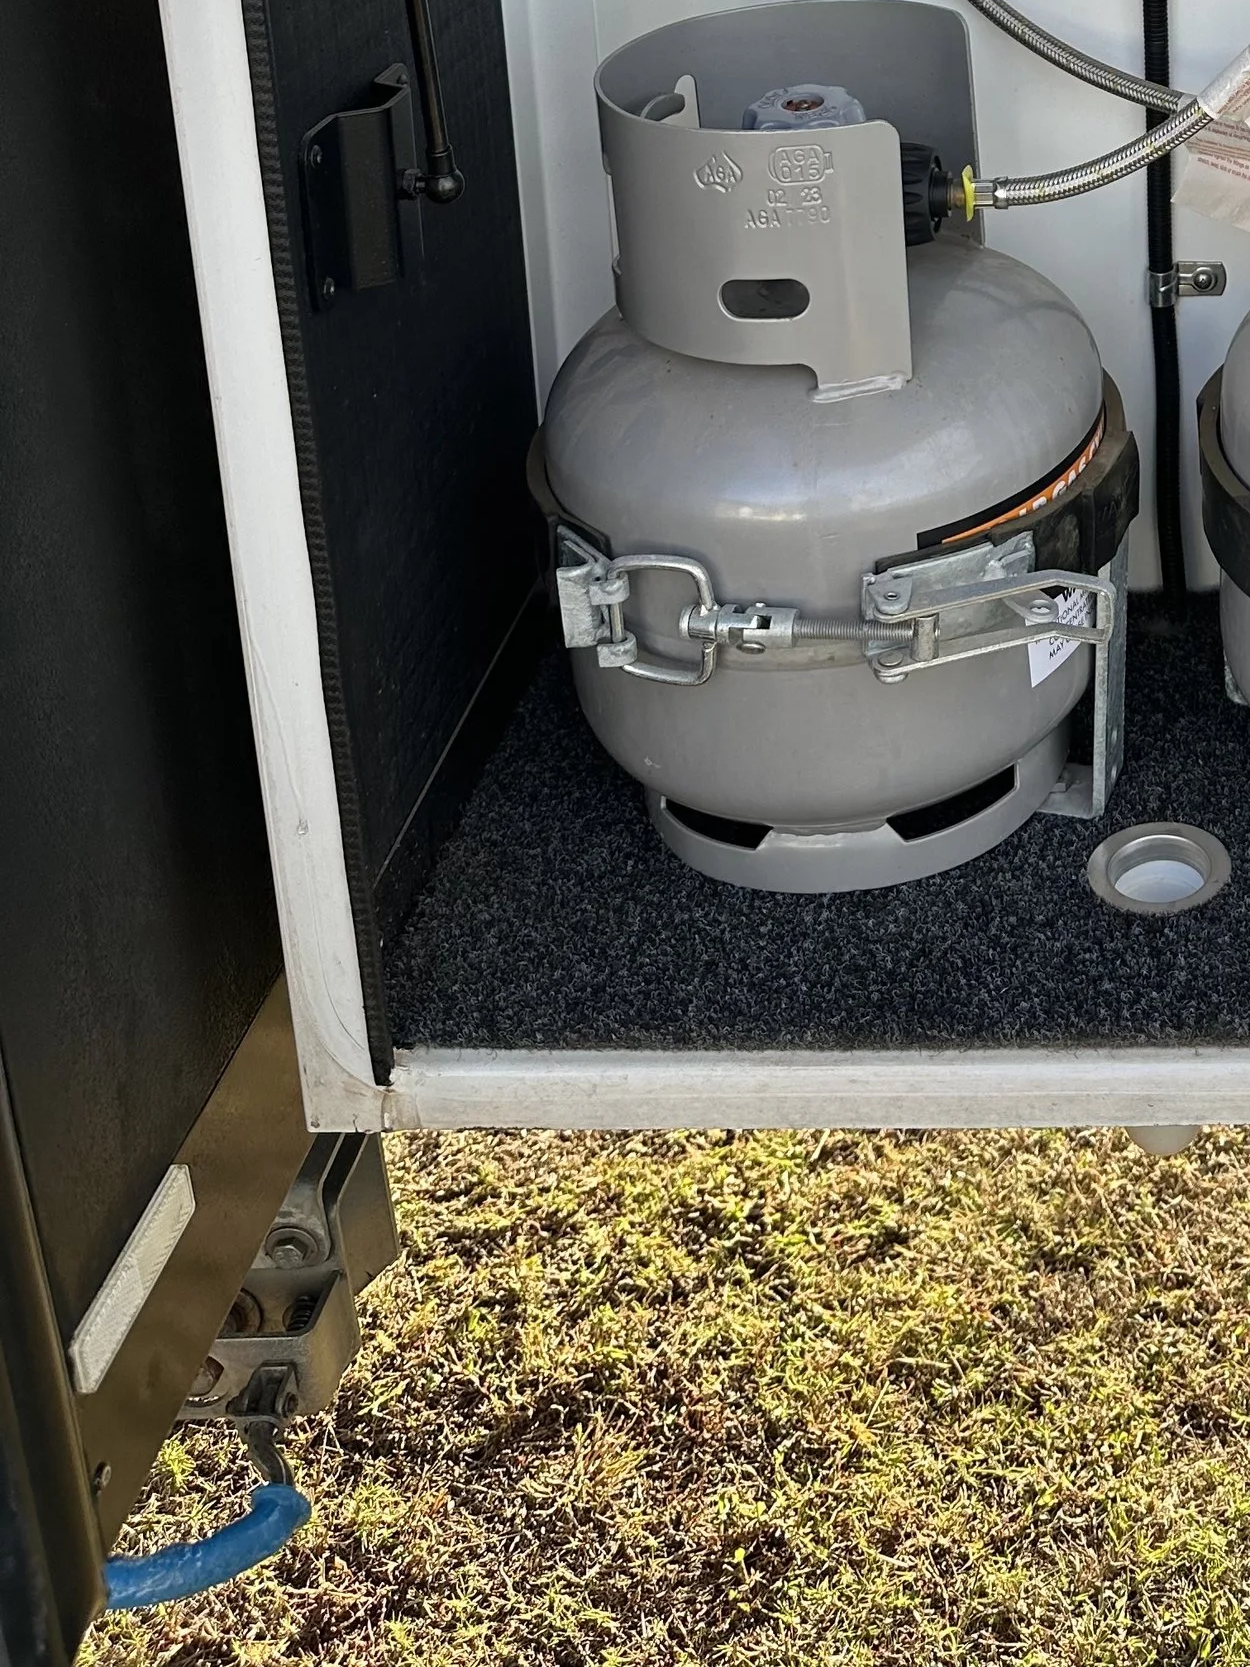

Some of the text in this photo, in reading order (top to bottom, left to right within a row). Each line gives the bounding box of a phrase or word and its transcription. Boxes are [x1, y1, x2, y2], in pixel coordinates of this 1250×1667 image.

[779, 149, 820, 166] AGA
[704, 165, 737, 183] AGA
[781, 166, 820, 182] 015
[744, 209, 781, 229] AGA
